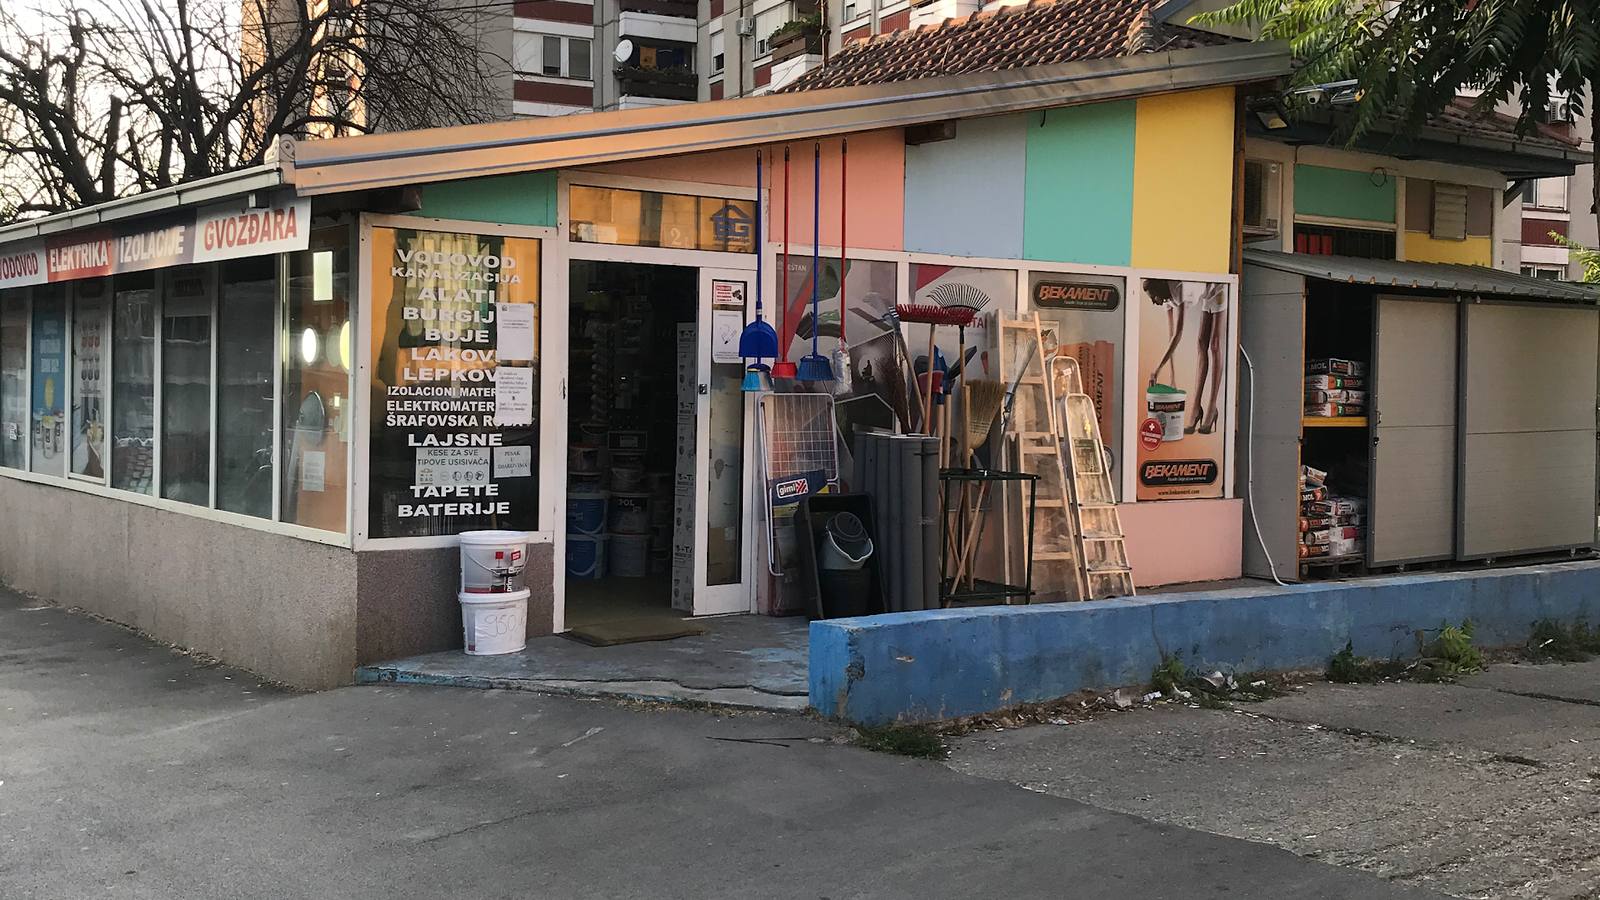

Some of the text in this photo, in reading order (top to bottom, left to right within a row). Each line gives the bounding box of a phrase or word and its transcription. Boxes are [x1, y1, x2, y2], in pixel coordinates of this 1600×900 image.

[204, 207, 298, 251] GVOŽĐARA
[120, 226, 185, 264] IZOLACIJE
[50, 241, 109, 273] ELEKTRIKA
[396, 248, 516, 270] VODOVOD
[787, 262, 807, 271] EŠTAN
[391, 266, 522, 284] KANALIZACIJA
[418, 287, 496, 304] ALATI
[1039, 286, 1111, 301] BEKAMENT
[403, 307, 495, 324] BURGIJ
[425, 328, 490, 343] BOJE
[411, 347, 498, 363] LAKOV
[403, 367, 497, 382] LEPKOV
[387, 386, 497, 397] IZOLACIONI MATER
[1096, 369, 1104, 424] KAMENT
[386, 400, 496, 412] ELEKTROMATER
[386, 412, 479, 427] ŠRAFOVSKA
[408, 433, 503, 447] LAJSNE
[448, 457, 489, 466] USISIVAČA
[1145, 464, 1211, 479] BEKAMENT
[410, 484, 499, 498] TAPETE
[779, 484, 796, 496] gimi
[397, 502, 510, 517] BATERIJE
